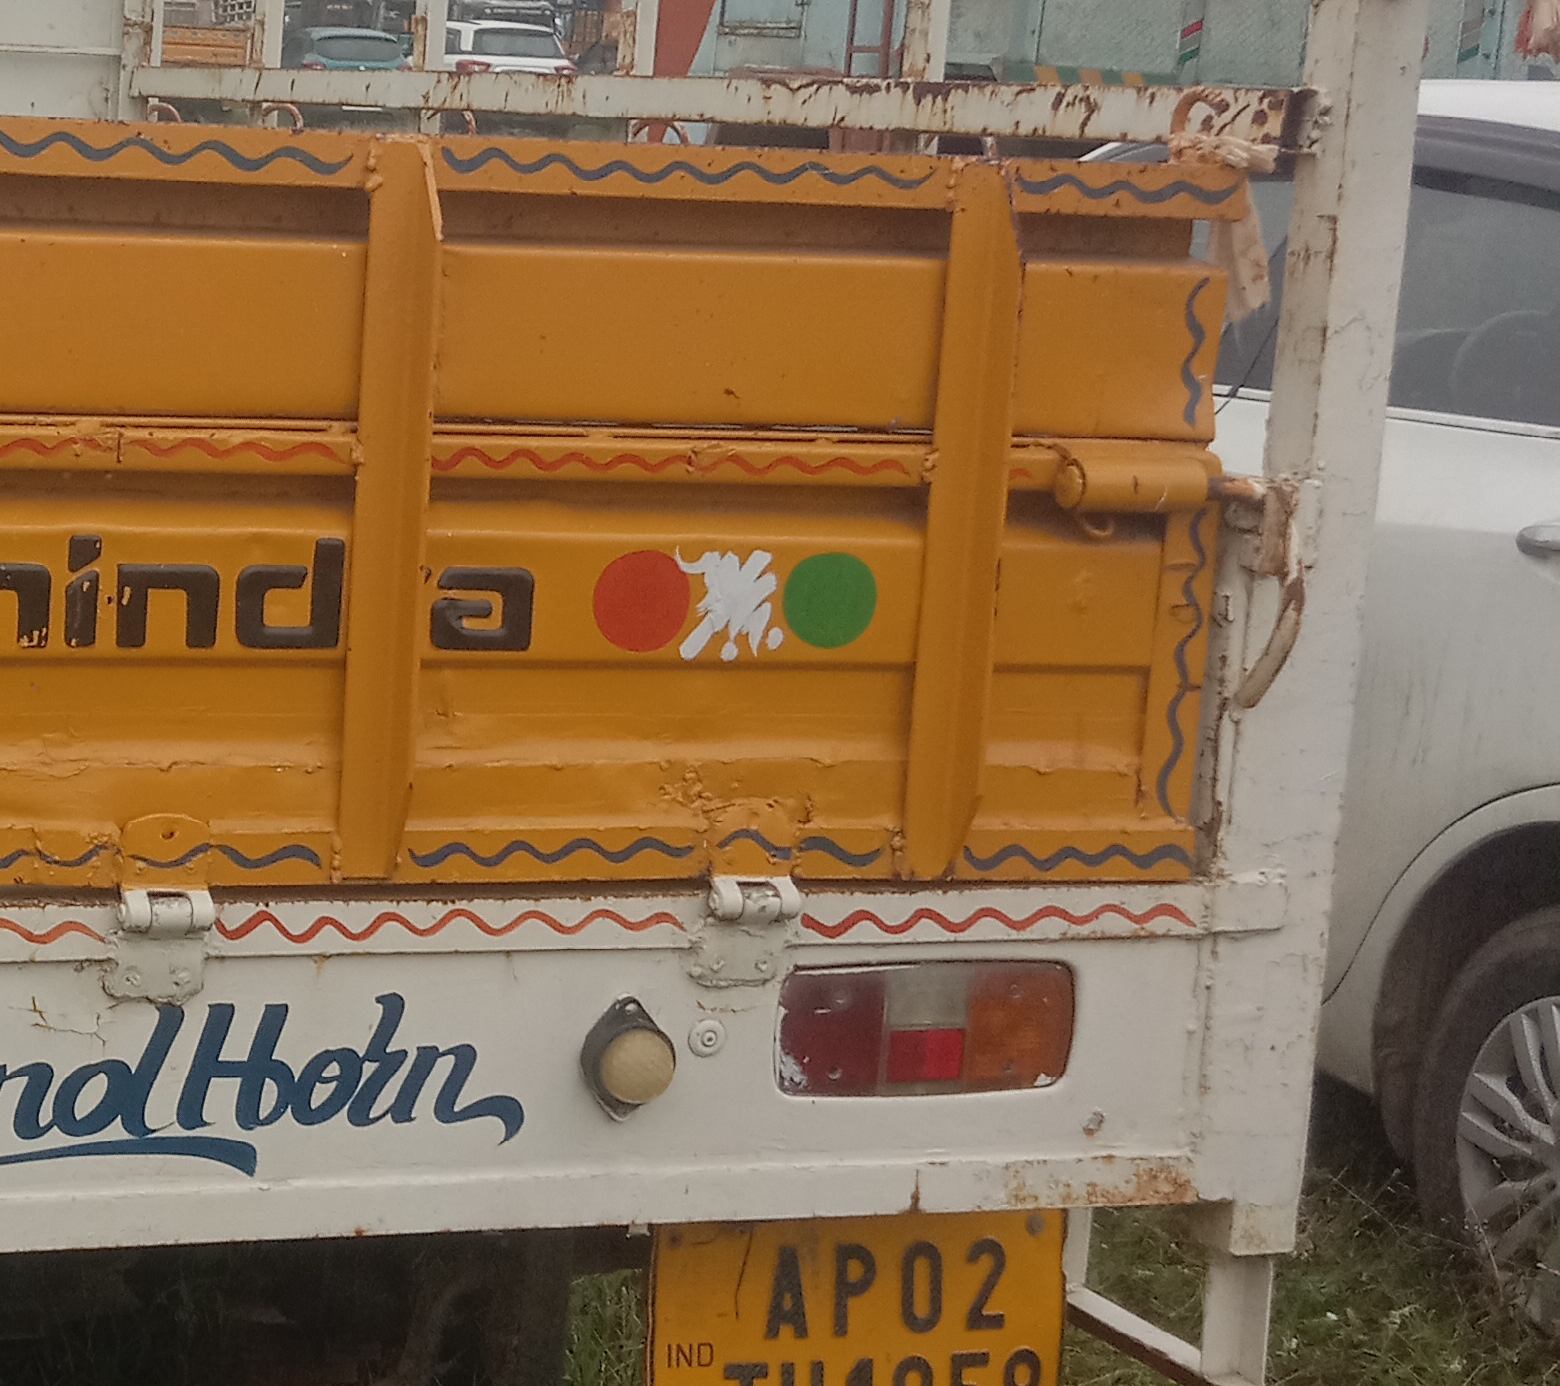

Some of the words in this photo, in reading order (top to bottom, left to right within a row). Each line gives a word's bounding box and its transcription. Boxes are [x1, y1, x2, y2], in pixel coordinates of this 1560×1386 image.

[176, 991, 525, 1147] Horn
[764, 1237, 1008, 1340] AP02
[666, 1342, 715, 1370] IND
